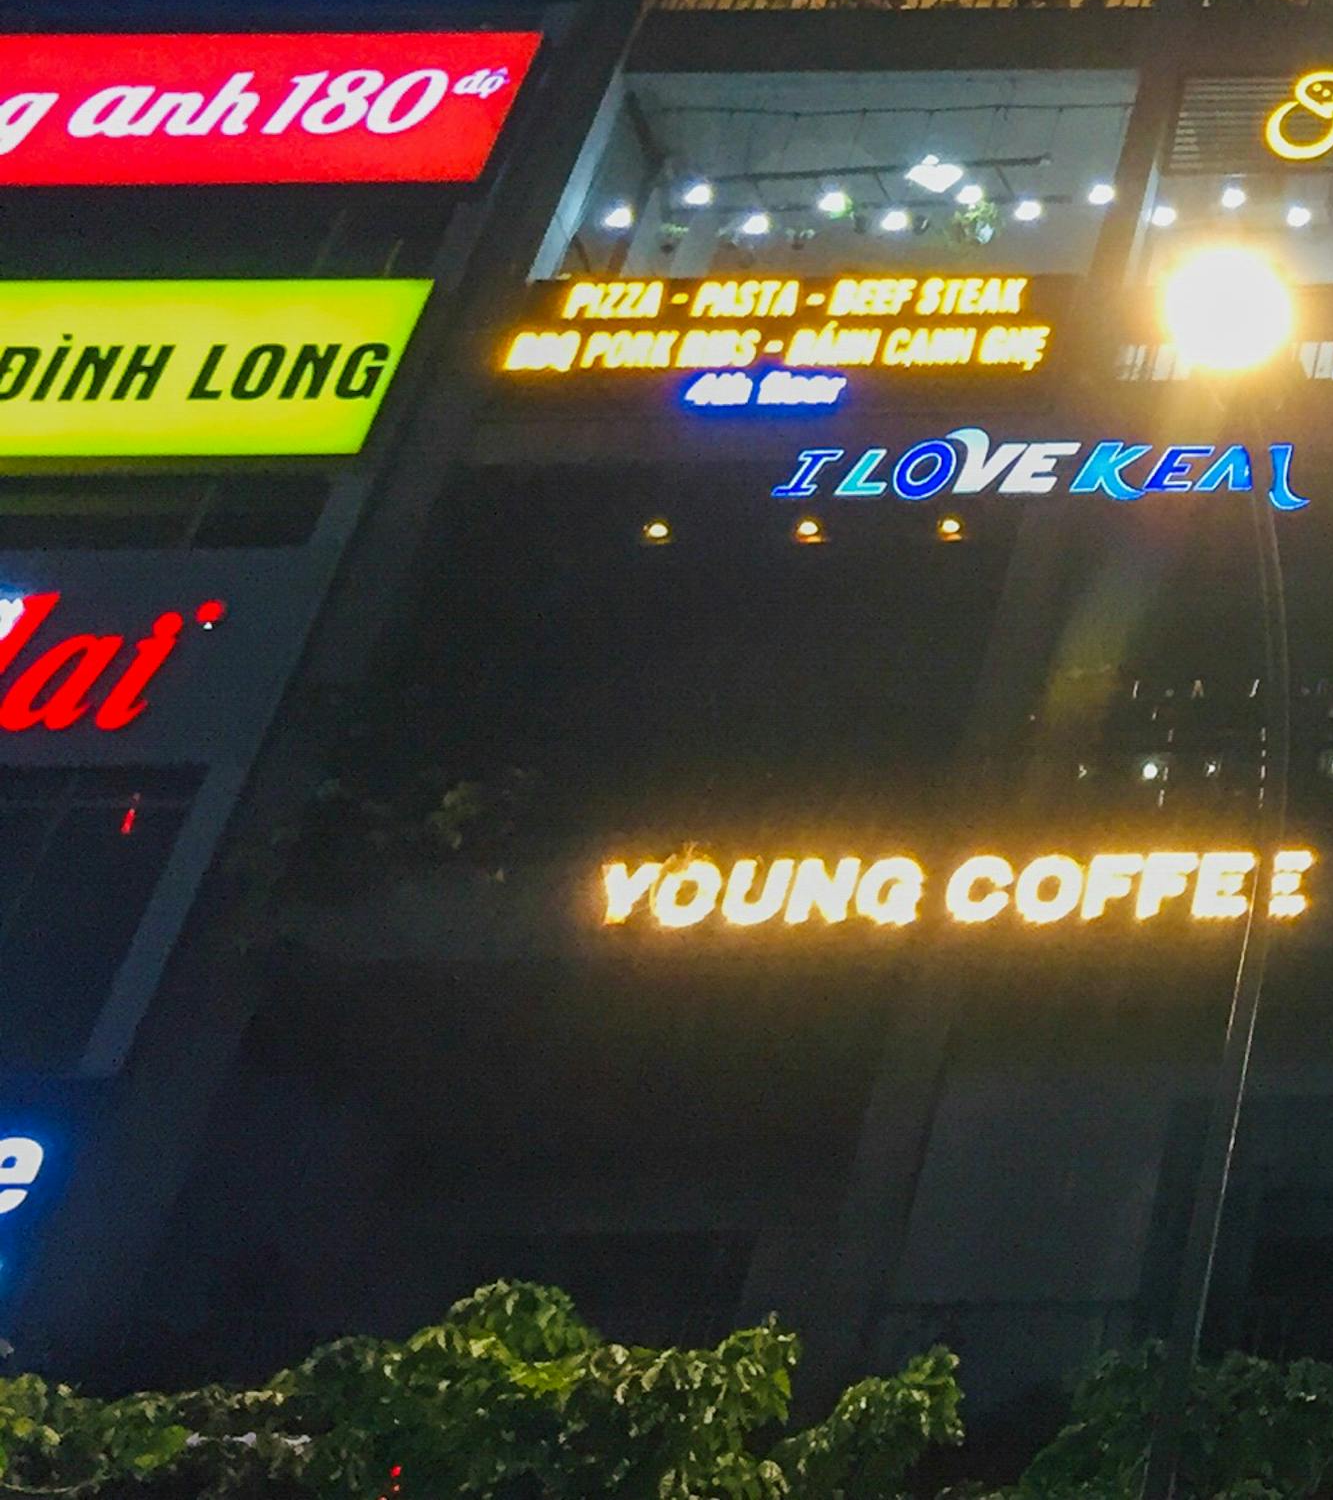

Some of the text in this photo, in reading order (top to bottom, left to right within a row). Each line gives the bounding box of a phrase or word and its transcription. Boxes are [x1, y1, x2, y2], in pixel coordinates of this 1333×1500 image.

[67, 71, 261, 138] anh
[261, 68, 450, 135] 180
[563, 281, 664, 320] PIZZA
[690, 279, 800, 318] PASTA
[828, 279, 917, 317] BEEF
[915, 277, 1029, 315] STEAK
[186, 342, 391, 401] LONG
[581, 329, 681, 369] PORK
[771, 447, 845, 498] I
[834, 427, 1082, 502] LOVE
[602, 850, 1319, 928] YOUNG COFFEE
